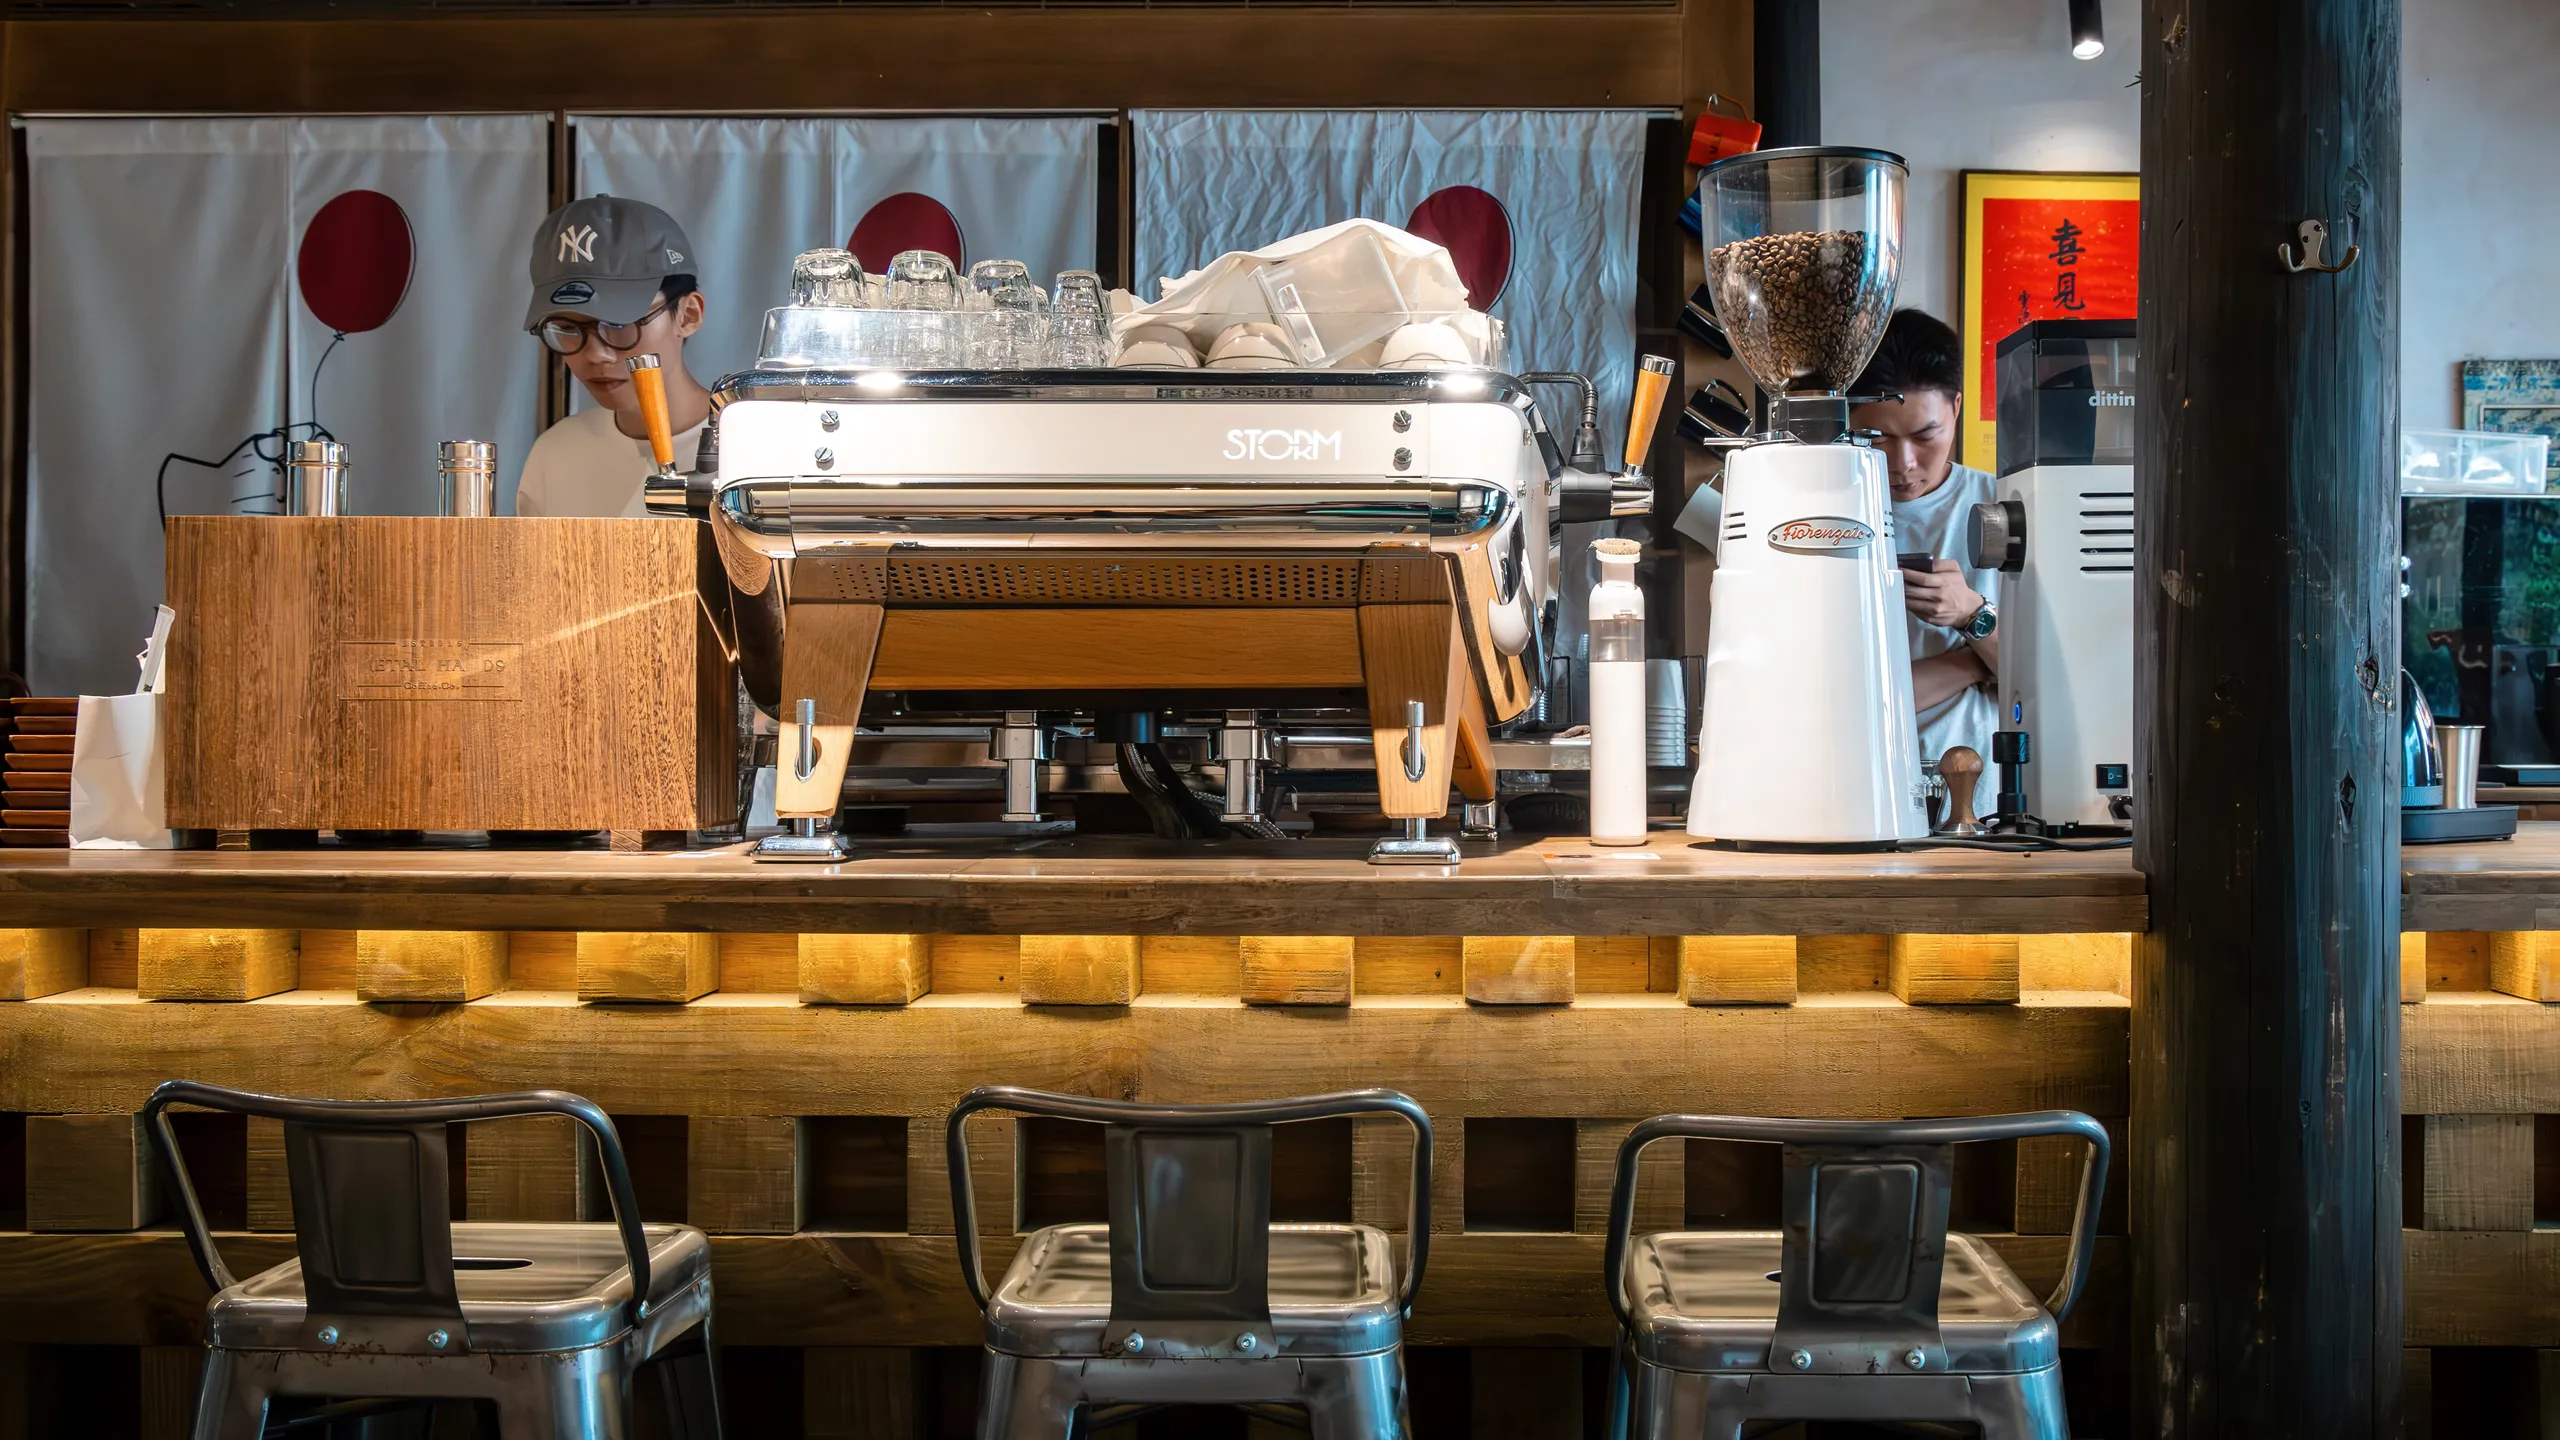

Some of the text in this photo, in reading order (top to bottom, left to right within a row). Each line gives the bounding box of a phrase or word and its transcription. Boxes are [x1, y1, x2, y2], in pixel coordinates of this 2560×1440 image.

[557, 224, 598, 263] NY
[2048, 218, 2086, 311] 喜見
[2088, 390, 2136, 407] dittin
[1222, 428, 1342, 461] STORM
[1782, 521, 1865, 546] Fiorenzato
[369, 659, 506, 672] ETAL HADS
